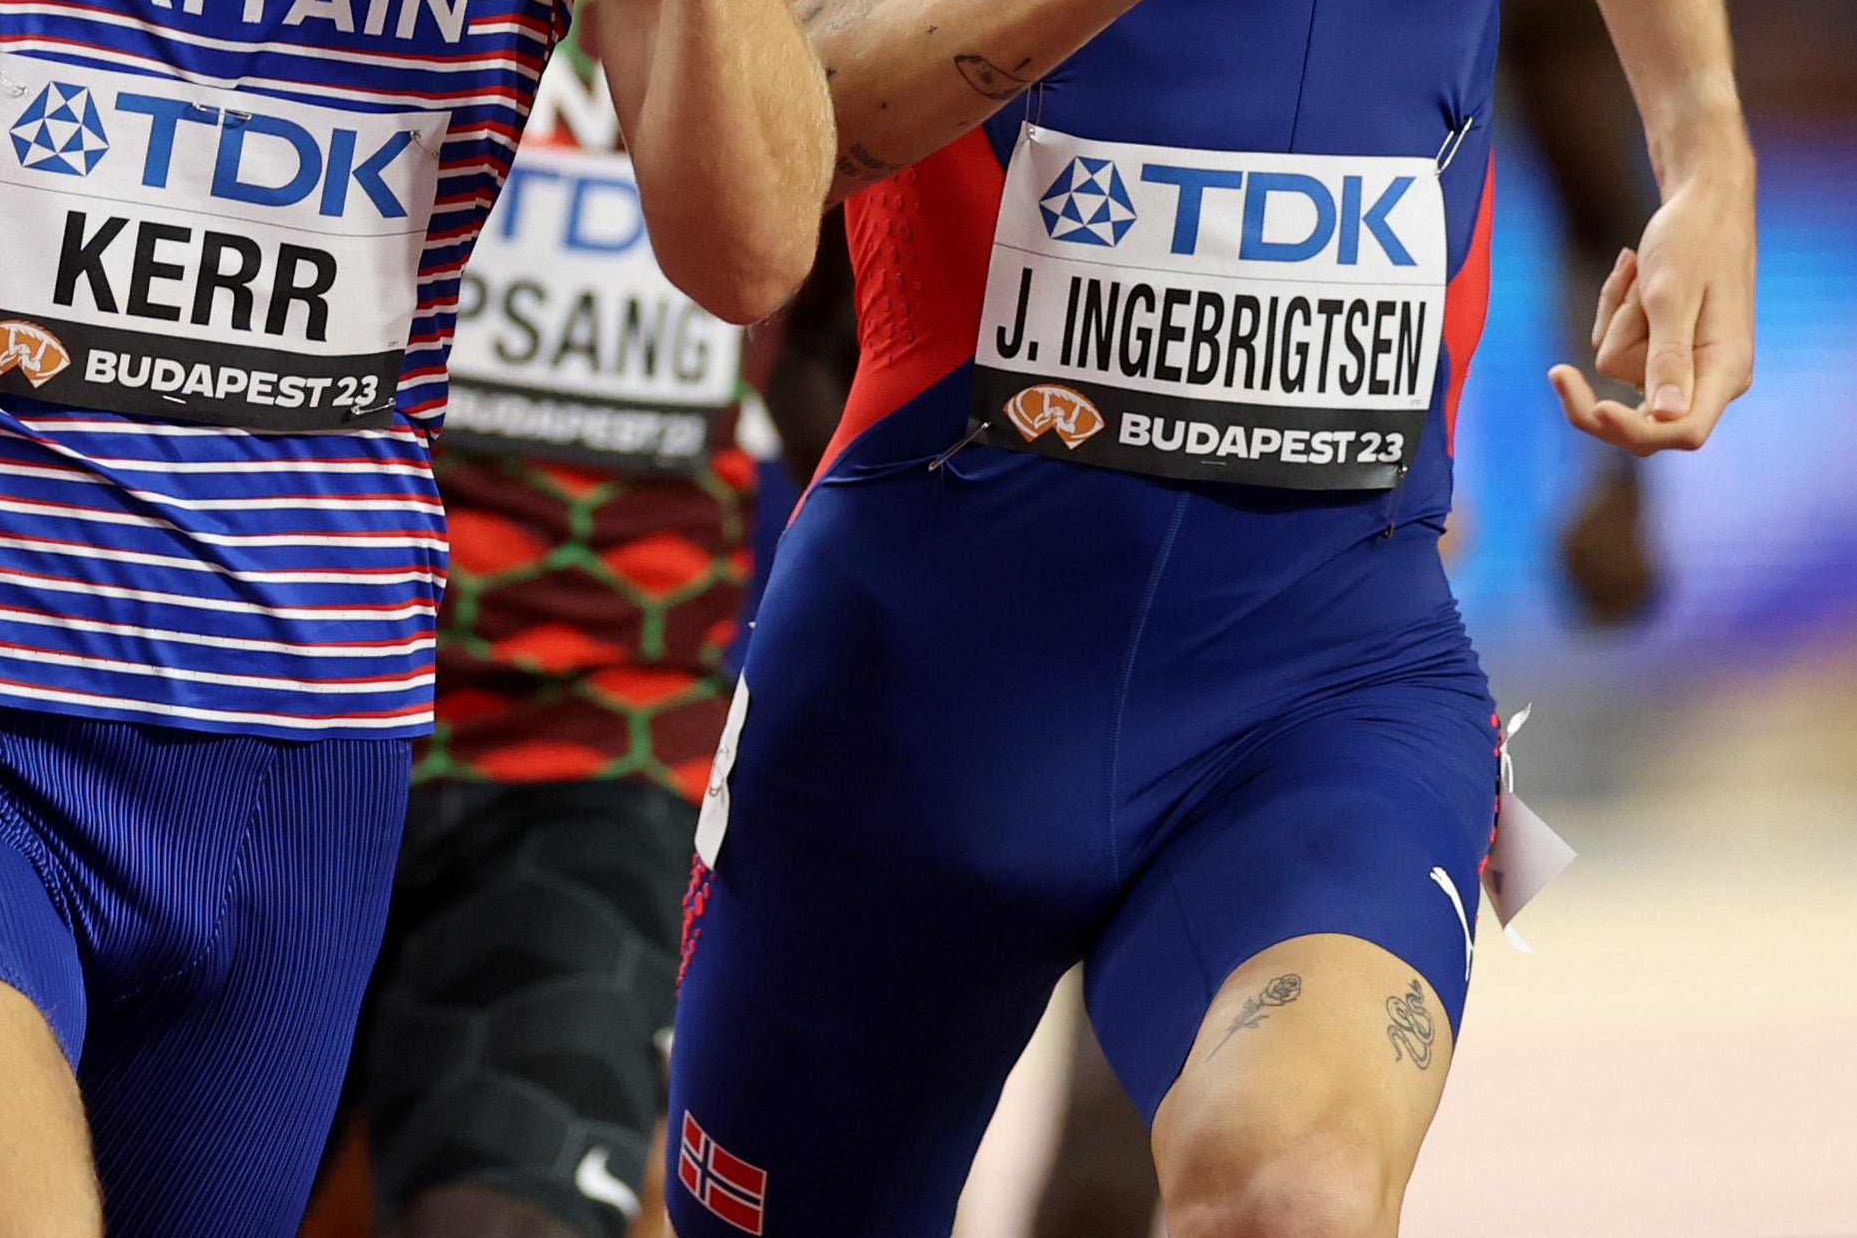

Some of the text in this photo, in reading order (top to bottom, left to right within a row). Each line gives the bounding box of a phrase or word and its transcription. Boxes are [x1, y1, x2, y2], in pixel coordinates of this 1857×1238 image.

[115, 91, 417, 219] TDK
[496, 165, 646, 255] TD
[1141, 163, 1419, 267] TDK
[52, 209, 338, 343] KERR
[460, 268, 713, 384] PSANG
[84, 348, 379, 410] BUDAPEST 23
[996, 267, 1427, 398] J. INGEBRIGTSEN
[1118, 412, 1405, 466] BUDAPEST 23
